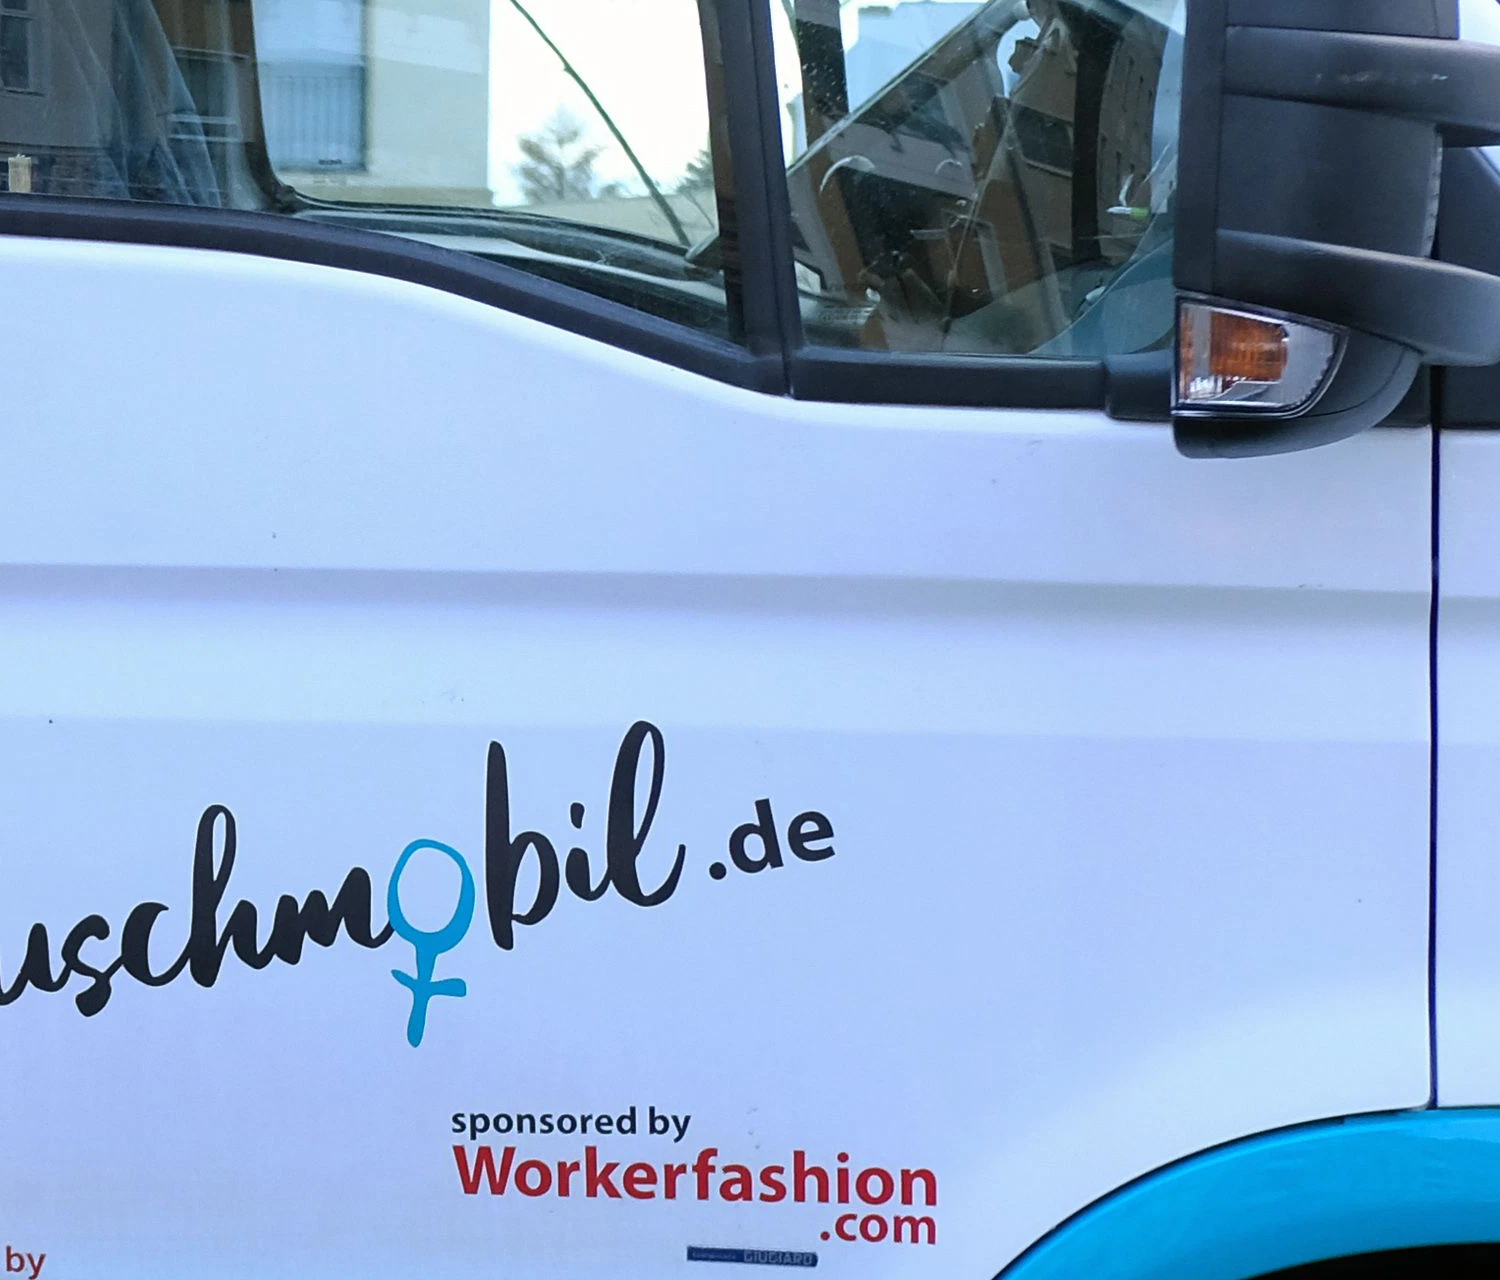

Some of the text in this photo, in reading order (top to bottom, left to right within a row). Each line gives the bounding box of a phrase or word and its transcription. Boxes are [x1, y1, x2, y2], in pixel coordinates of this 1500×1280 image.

[452, 1106, 691, 1143] sponsored by
[453, 1145, 938, 1207] Workerfashion
[820, 1213, 937, 1245] .com
[5, 1245, 46, 1280] by
